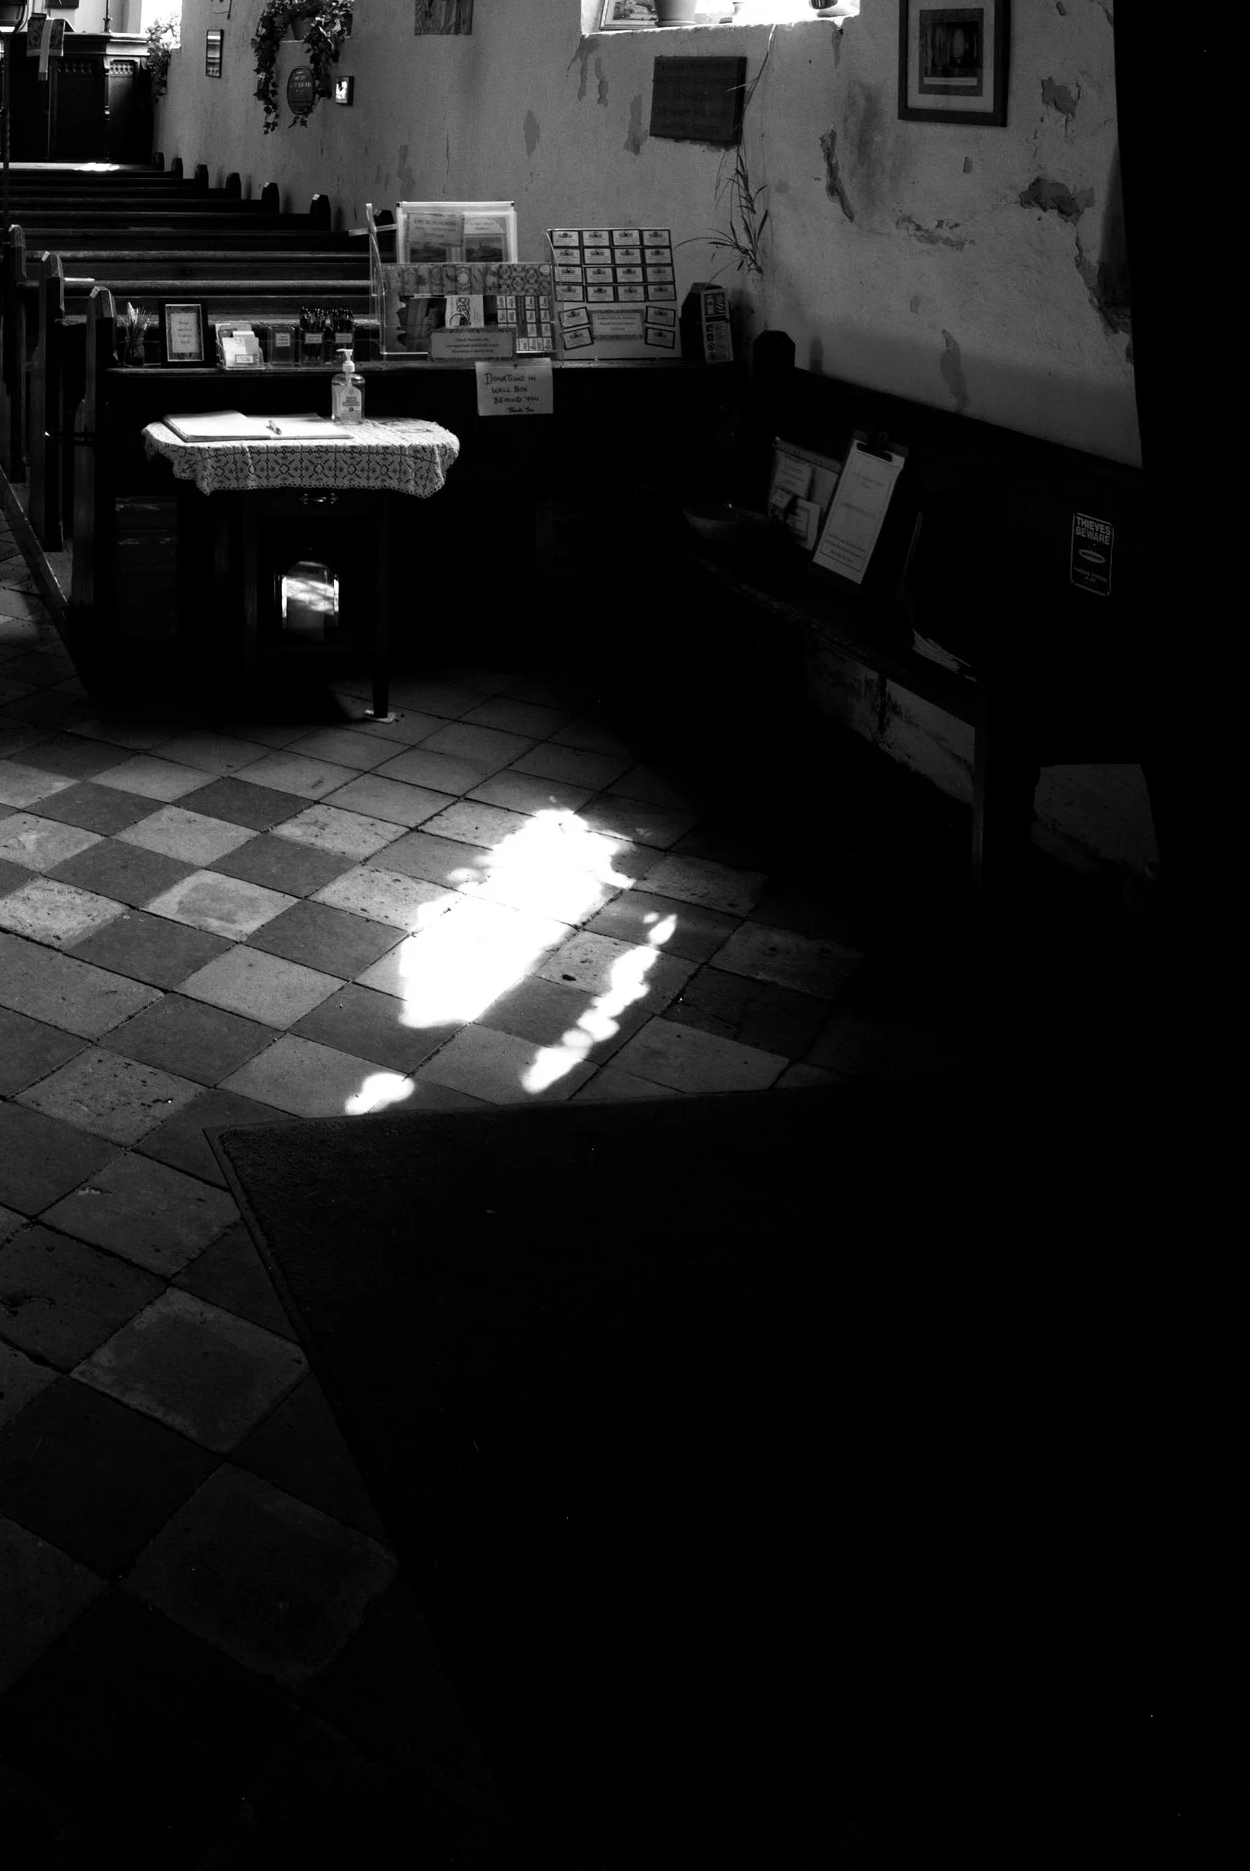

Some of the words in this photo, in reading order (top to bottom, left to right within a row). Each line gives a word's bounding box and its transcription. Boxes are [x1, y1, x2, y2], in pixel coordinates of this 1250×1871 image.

[484, 373, 525, 385] DONATIONS
[491, 386, 512, 394] WALL
[514, 385, 528, 393] BOX
[493, 396, 523, 405] BEHIND
[1075, 515, 1111, 537] THIEVES
[1075, 526, 1111, 546] BEWARE
